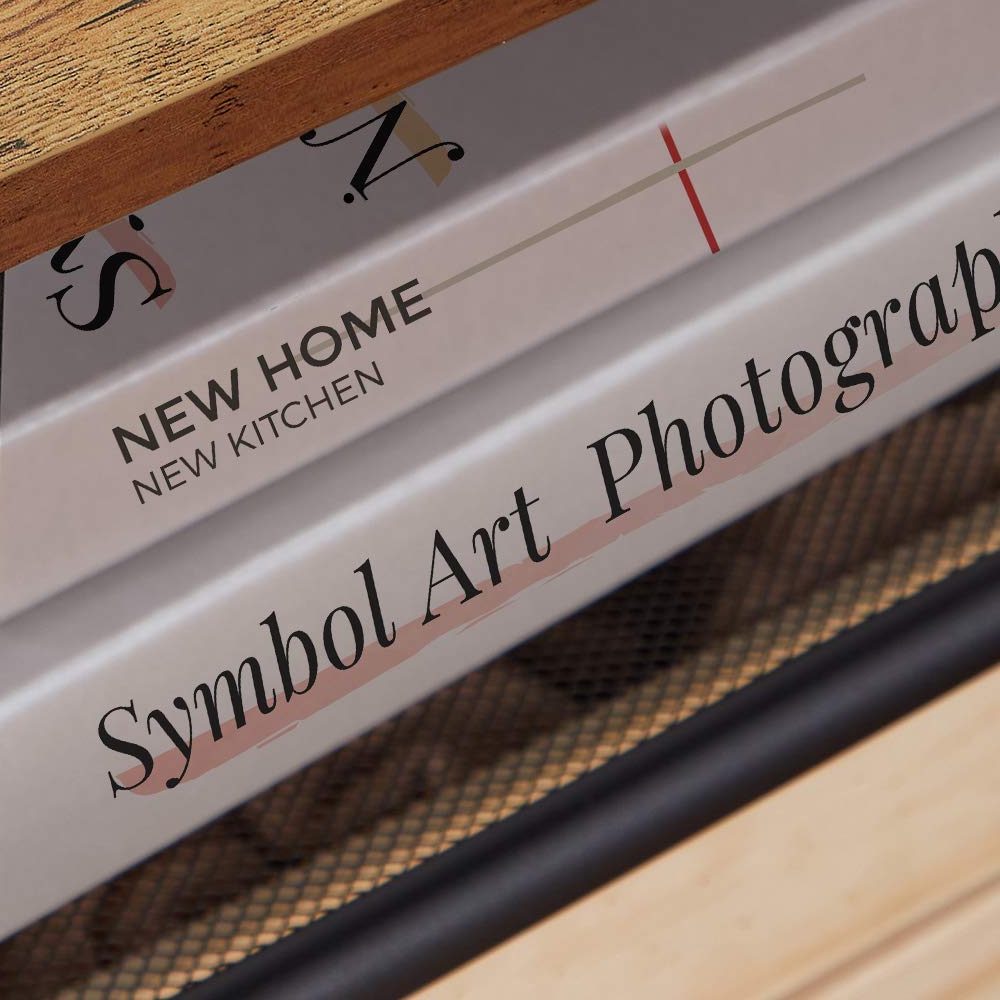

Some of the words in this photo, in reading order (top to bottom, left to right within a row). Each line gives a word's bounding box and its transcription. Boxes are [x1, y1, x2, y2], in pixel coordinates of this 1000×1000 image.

[112, 368, 240, 463] NEW
[257, 278, 432, 392] HOME
[132, 441, 217, 504] NEW
[227, 361, 385, 457] KITCHEN
[97, 558, 397, 799] Symbol
[421, 486, 551, 626] Art
[586, 210, 1000, 524] Photograp
